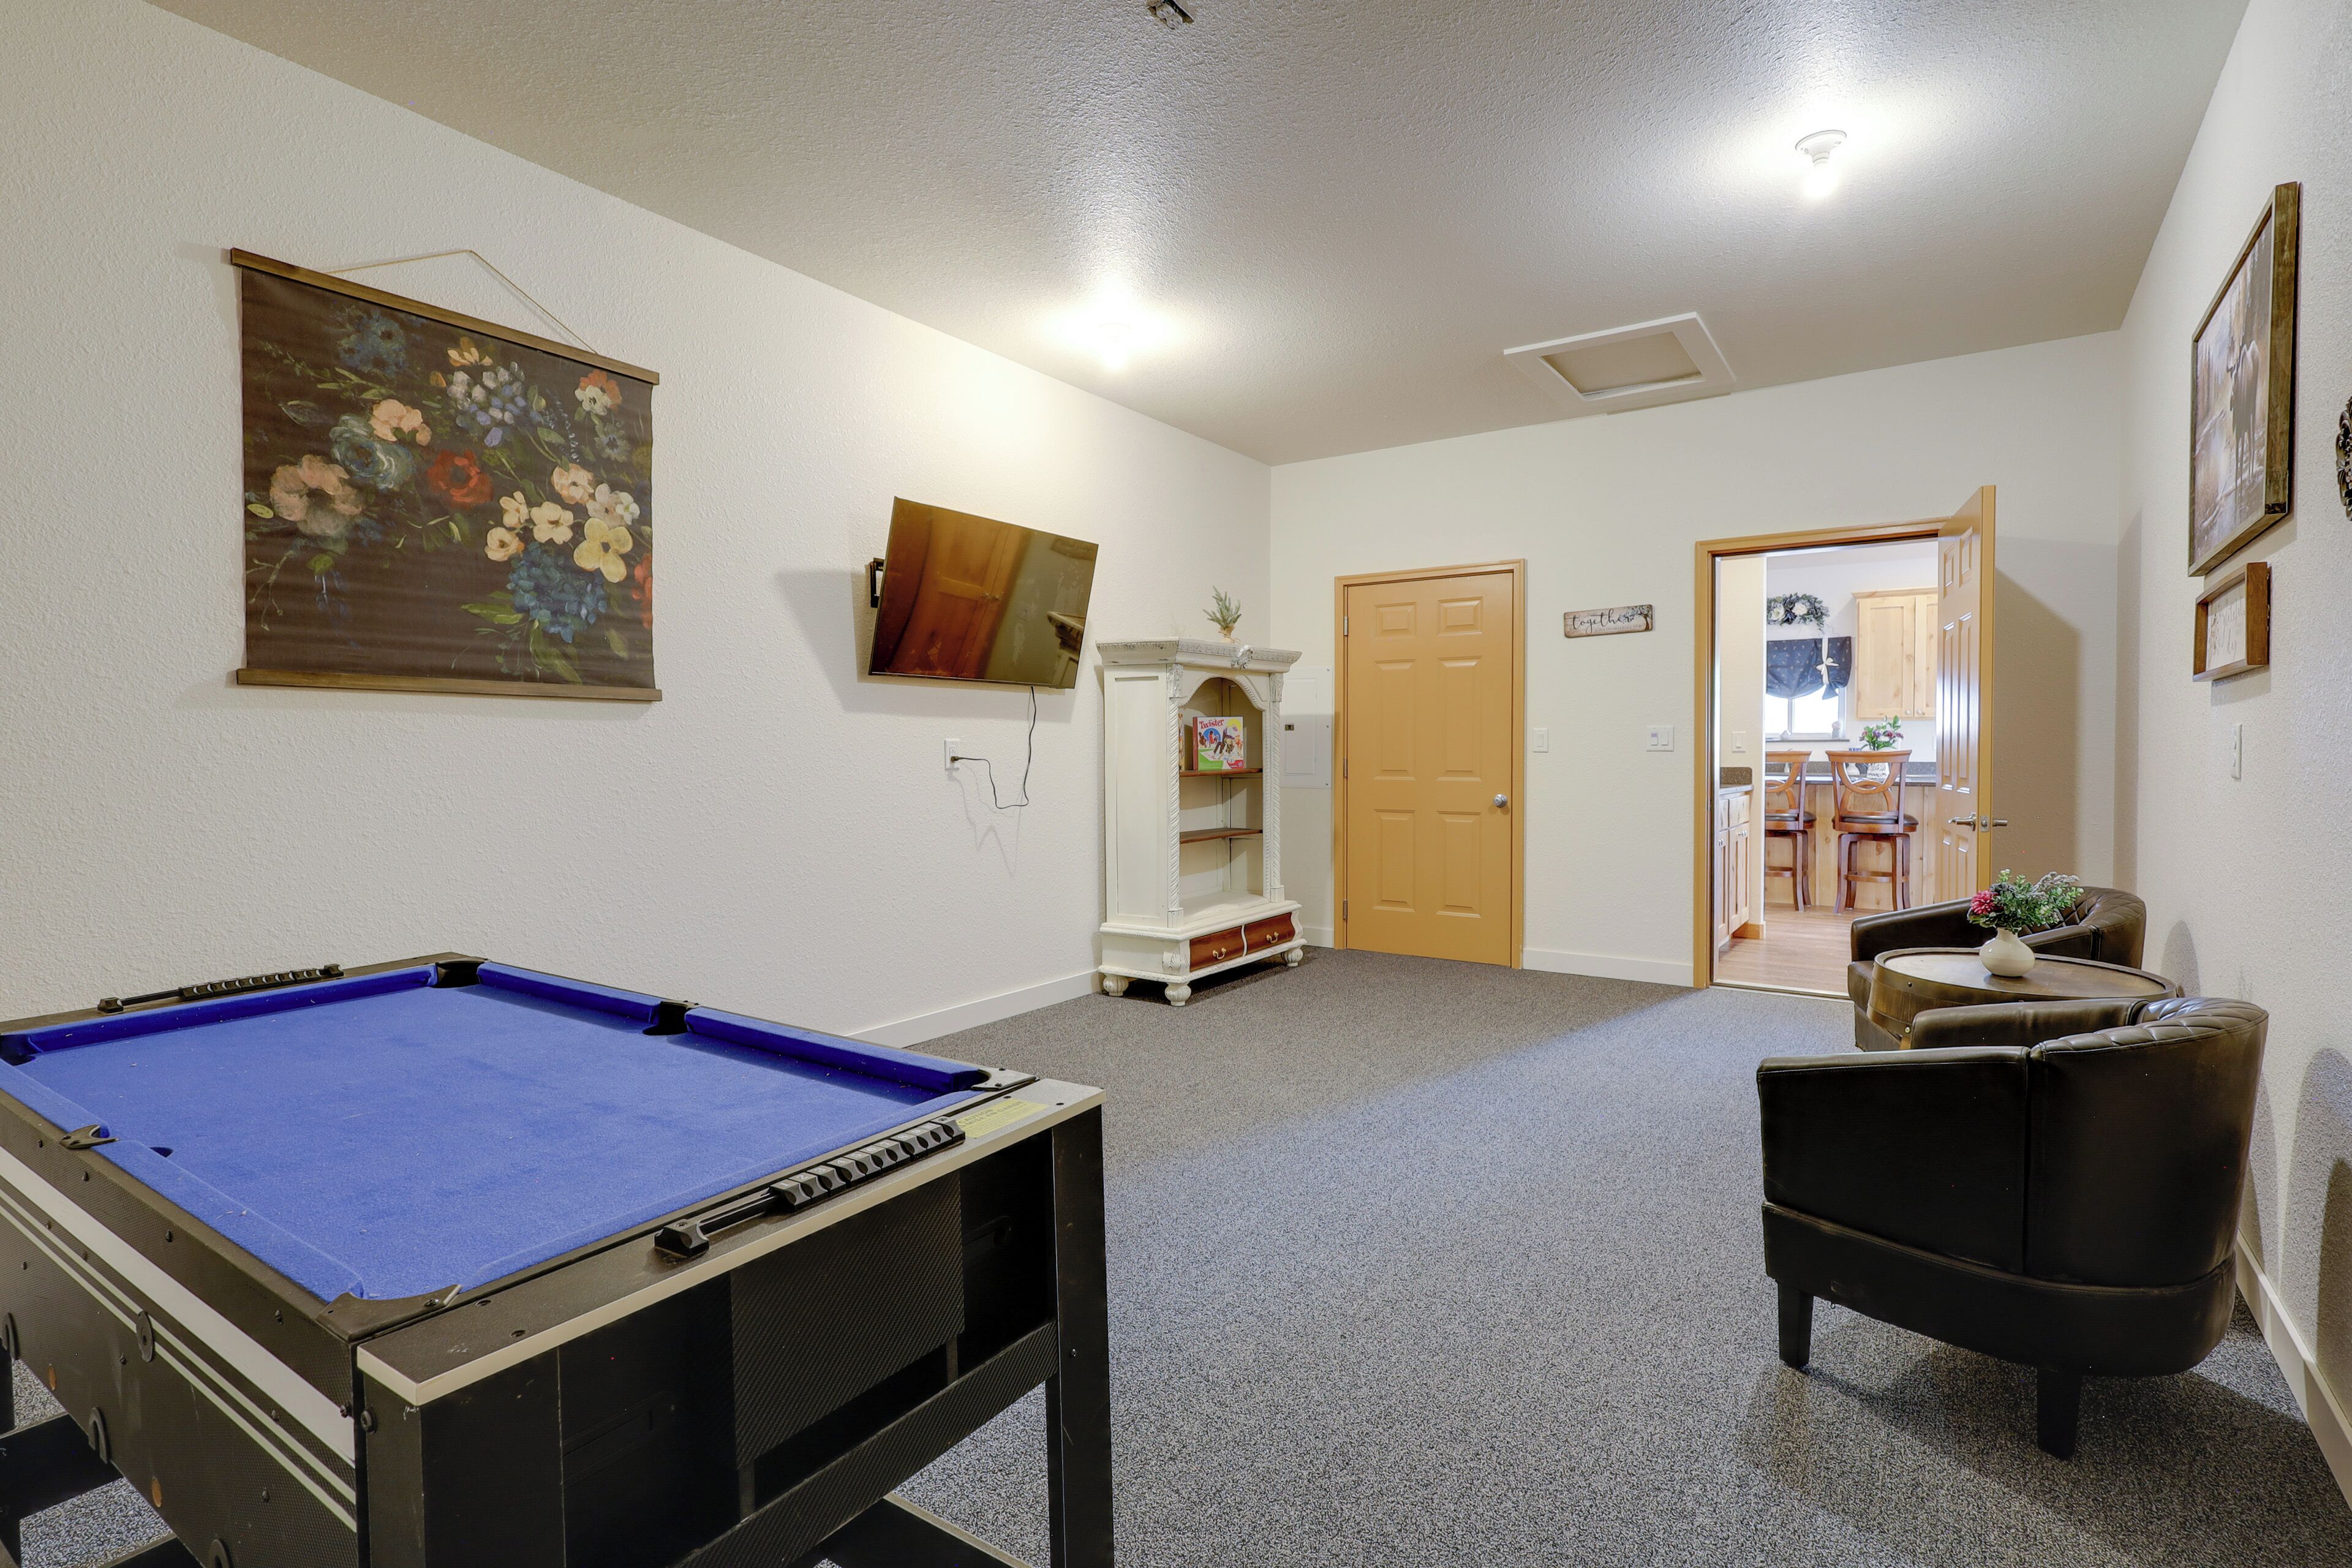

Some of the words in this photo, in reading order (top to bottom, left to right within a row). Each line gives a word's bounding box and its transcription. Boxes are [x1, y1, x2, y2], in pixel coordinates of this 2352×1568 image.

[1565, 608, 1634, 634] together
[1199, 719, 1224, 729] Twister
[959, 1109, 993, 1123] CAUTION
